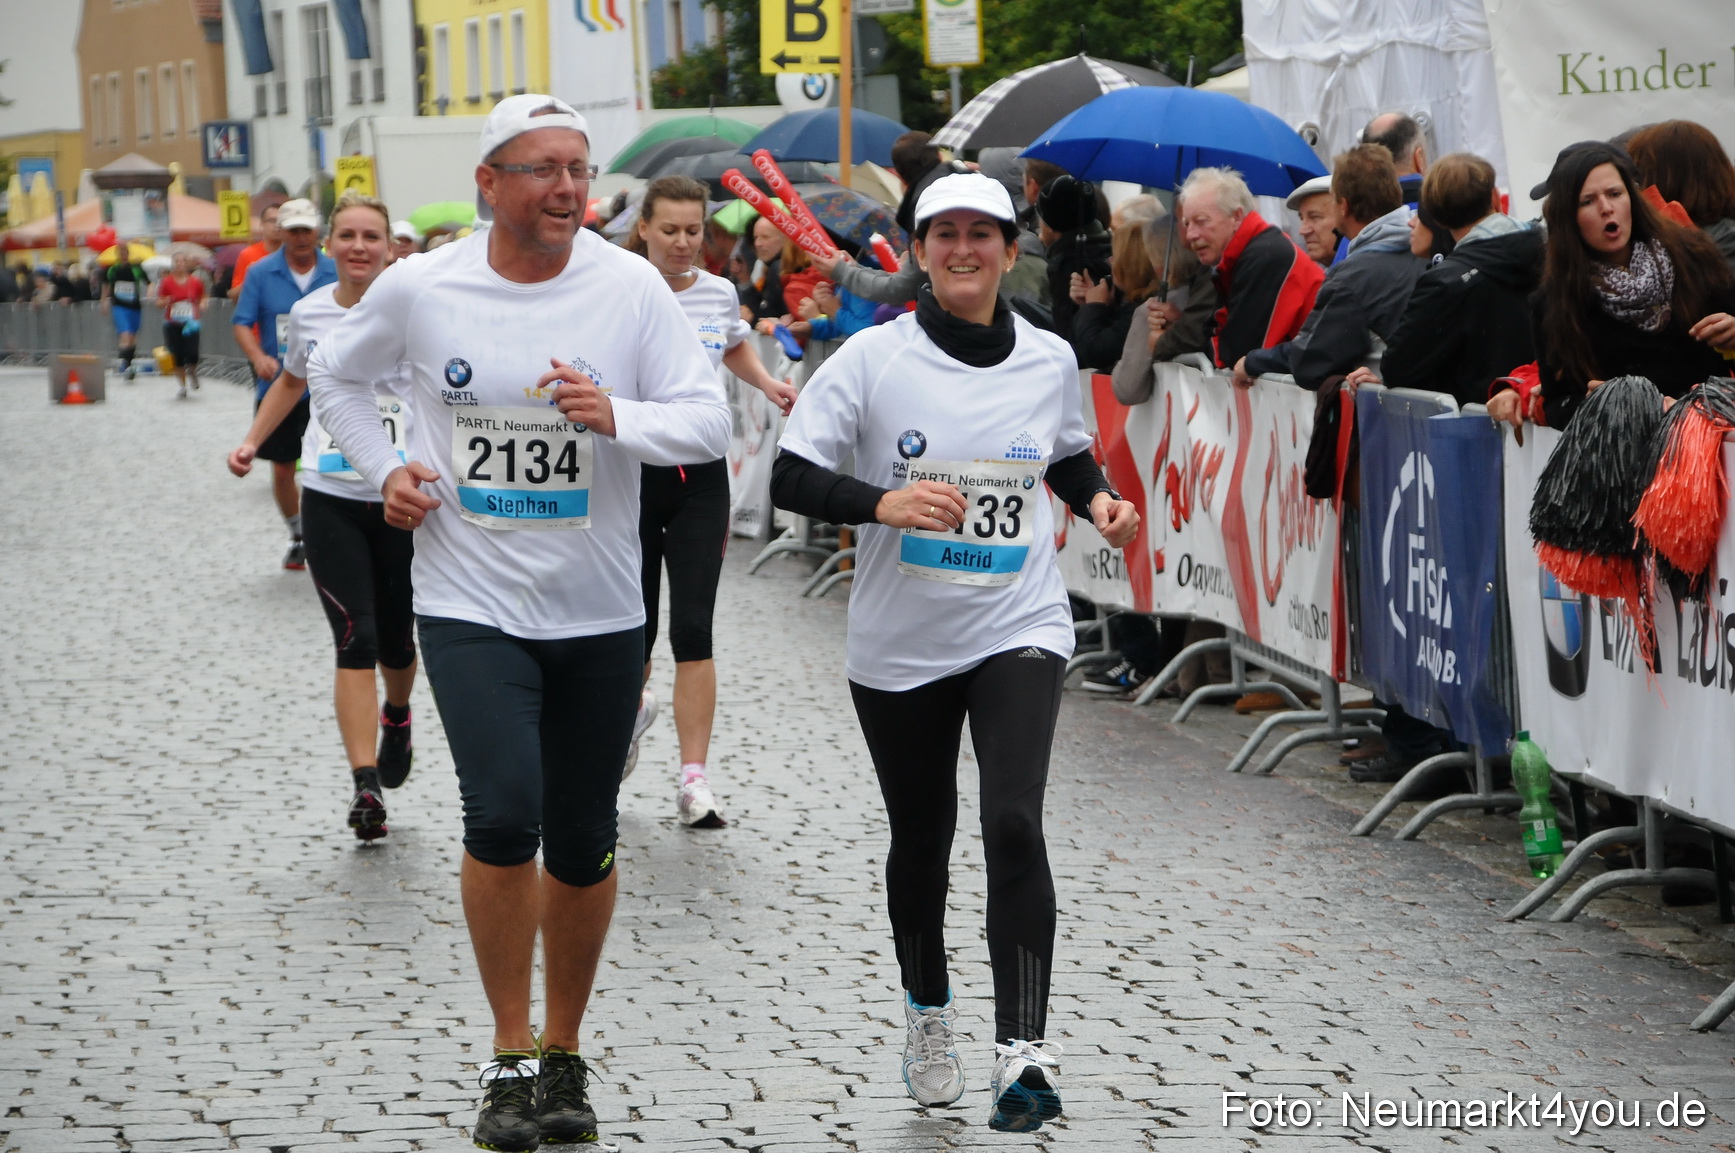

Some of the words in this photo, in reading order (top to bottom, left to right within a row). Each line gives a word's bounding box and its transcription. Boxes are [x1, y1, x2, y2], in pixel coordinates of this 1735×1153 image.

[785, 0, 828, 42] B
[1557, 48, 1716, 95] Kinder
[227, 205, 243, 227] D
[769, 207, 798, 236] BKK
[441, 389, 478, 401] PARTL
[456, 416, 501, 431] PARTL
[504, 420, 568, 432] Neumarkt
[467, 436, 580, 484] 2134
[910, 470, 955, 485] PARTL
[958, 475, 1018, 488] Neumarkt
[486, 494, 558, 518] Stephan
[940, 547, 993, 569] Astrid
